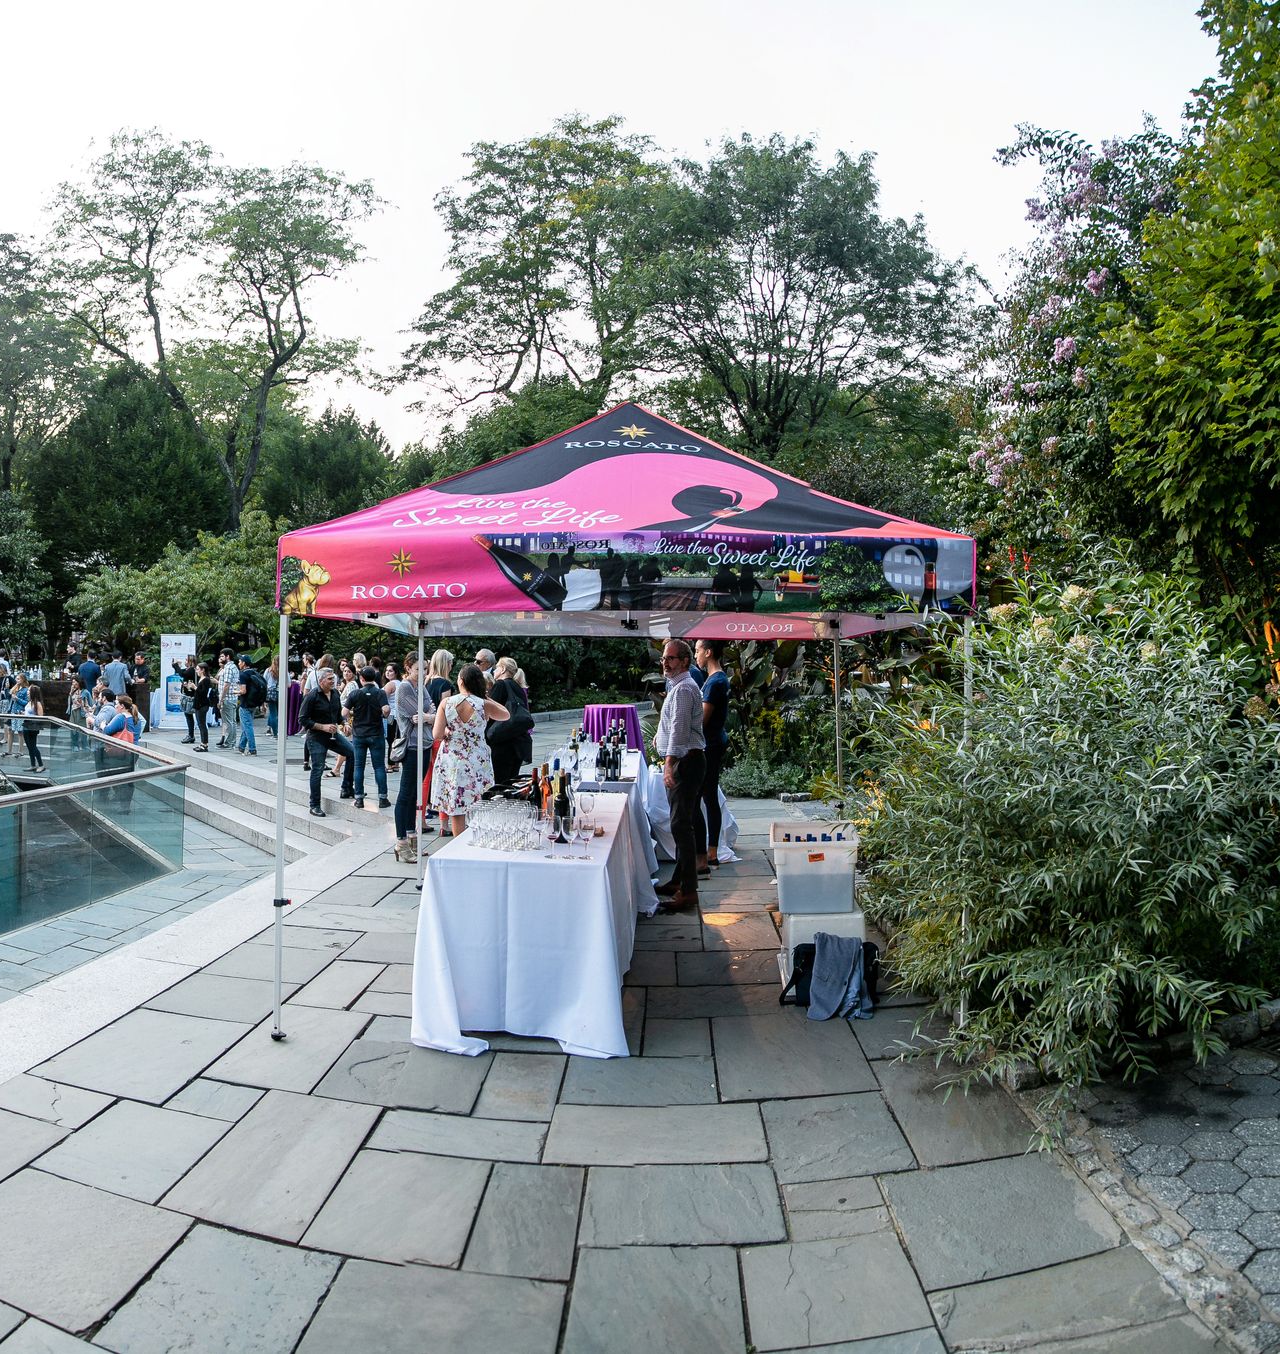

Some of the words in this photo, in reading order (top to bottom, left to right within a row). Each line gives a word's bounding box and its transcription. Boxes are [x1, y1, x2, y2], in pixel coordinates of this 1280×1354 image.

[564, 440, 702, 453] ROSCATO
[444, 497, 517, 510] Live
[521, 497, 568, 509] the
[392, 507, 520, 528] Sweet
[522, 507, 624, 529] Life
[648, 537, 686, 555] Live
[687, 539, 711, 554] the
[707, 542, 769, 566] Sweet
[770, 544, 817, 574] Life
